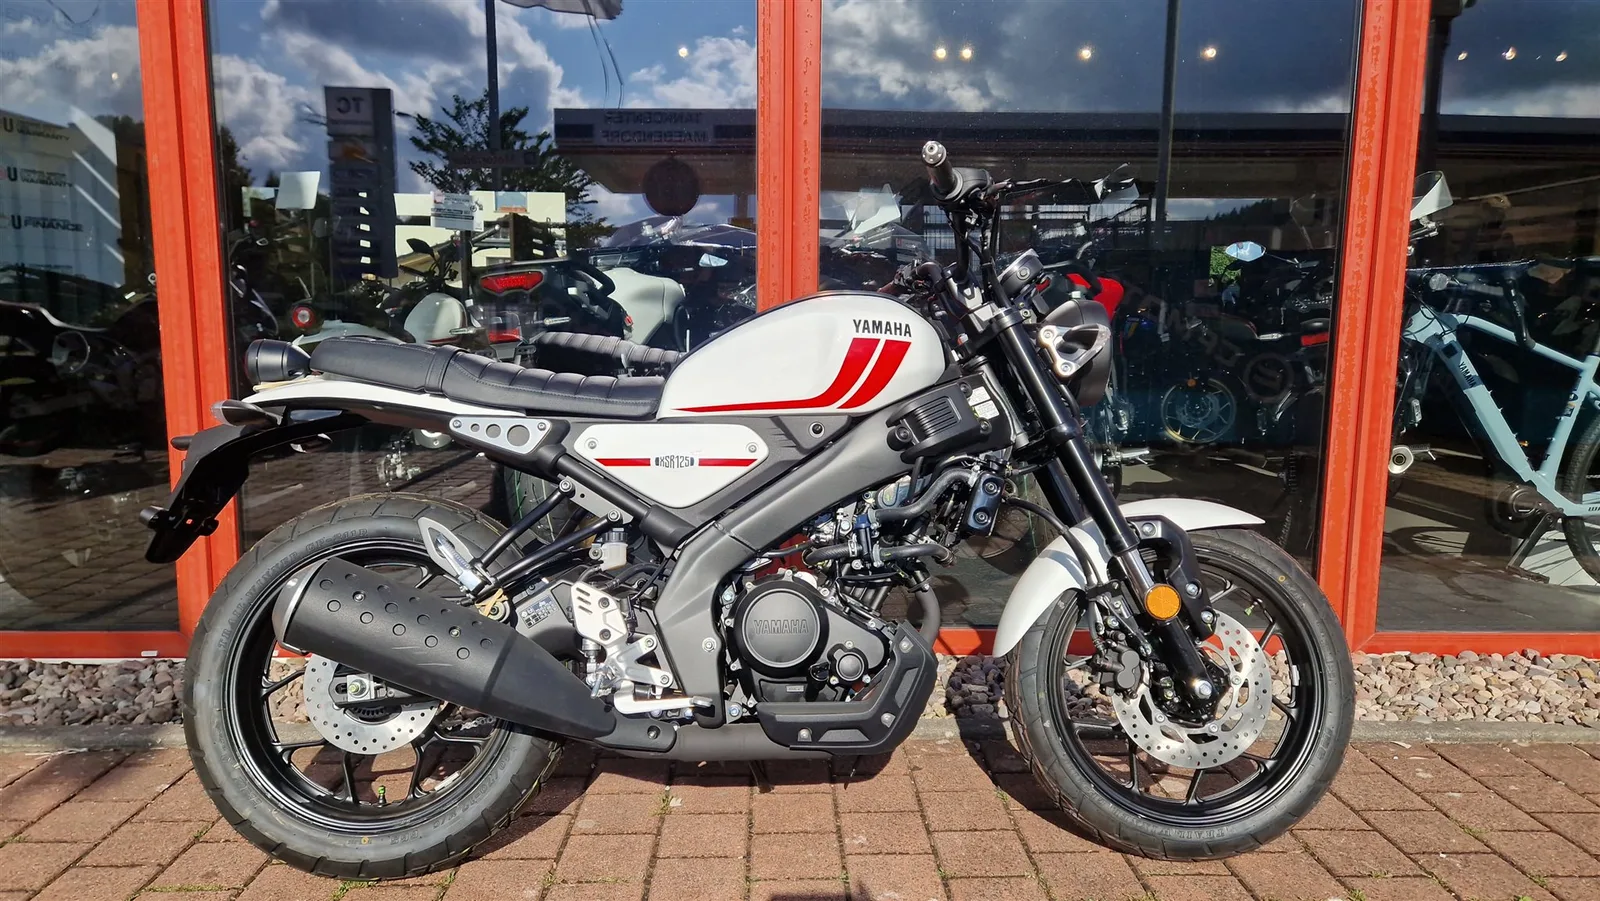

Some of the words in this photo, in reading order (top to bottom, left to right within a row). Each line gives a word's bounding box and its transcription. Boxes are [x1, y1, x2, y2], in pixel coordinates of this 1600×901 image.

[24, 218, 84, 232] FINANCE
[852, 319, 912, 338] YAMAHA
[1458, 361, 1477, 389] YAMAHA
[659, 454, 690, 469] XSR125
[753, 618, 809, 635] YAMAHA
